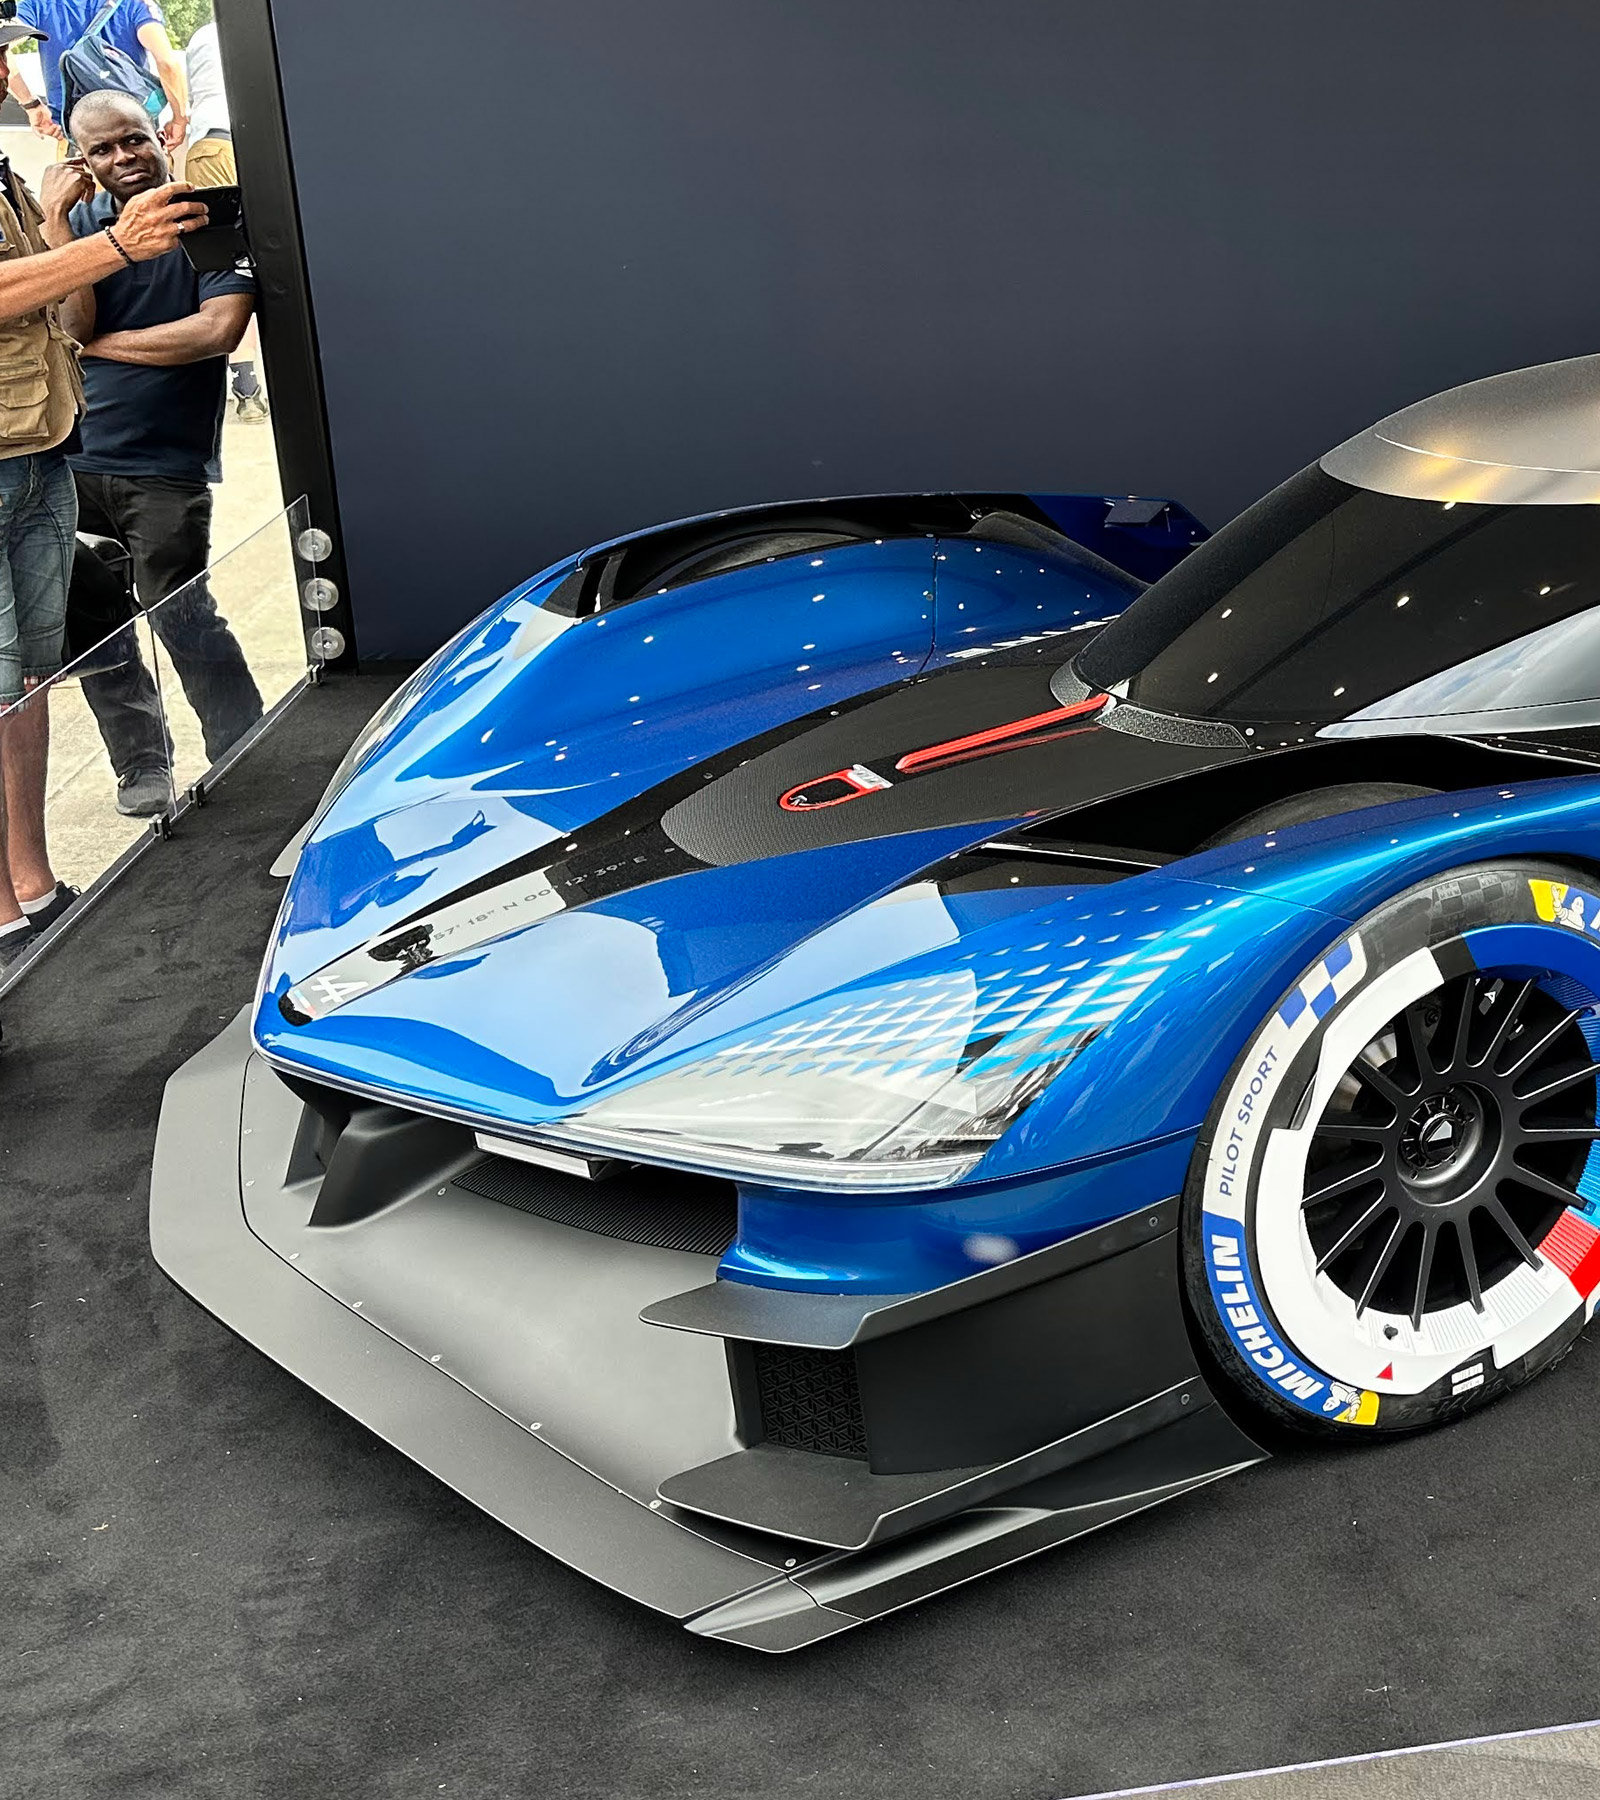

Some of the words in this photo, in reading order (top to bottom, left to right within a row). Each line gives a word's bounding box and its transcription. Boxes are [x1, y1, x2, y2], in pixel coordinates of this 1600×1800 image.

[502, 901, 518, 911] N
[633, 855, 648, 864] E
[1219, 1127, 1243, 1197] PILOT
[1237, 1045, 1279, 1125] SPORT
[1211, 1234, 1325, 1401] MICHELIN
